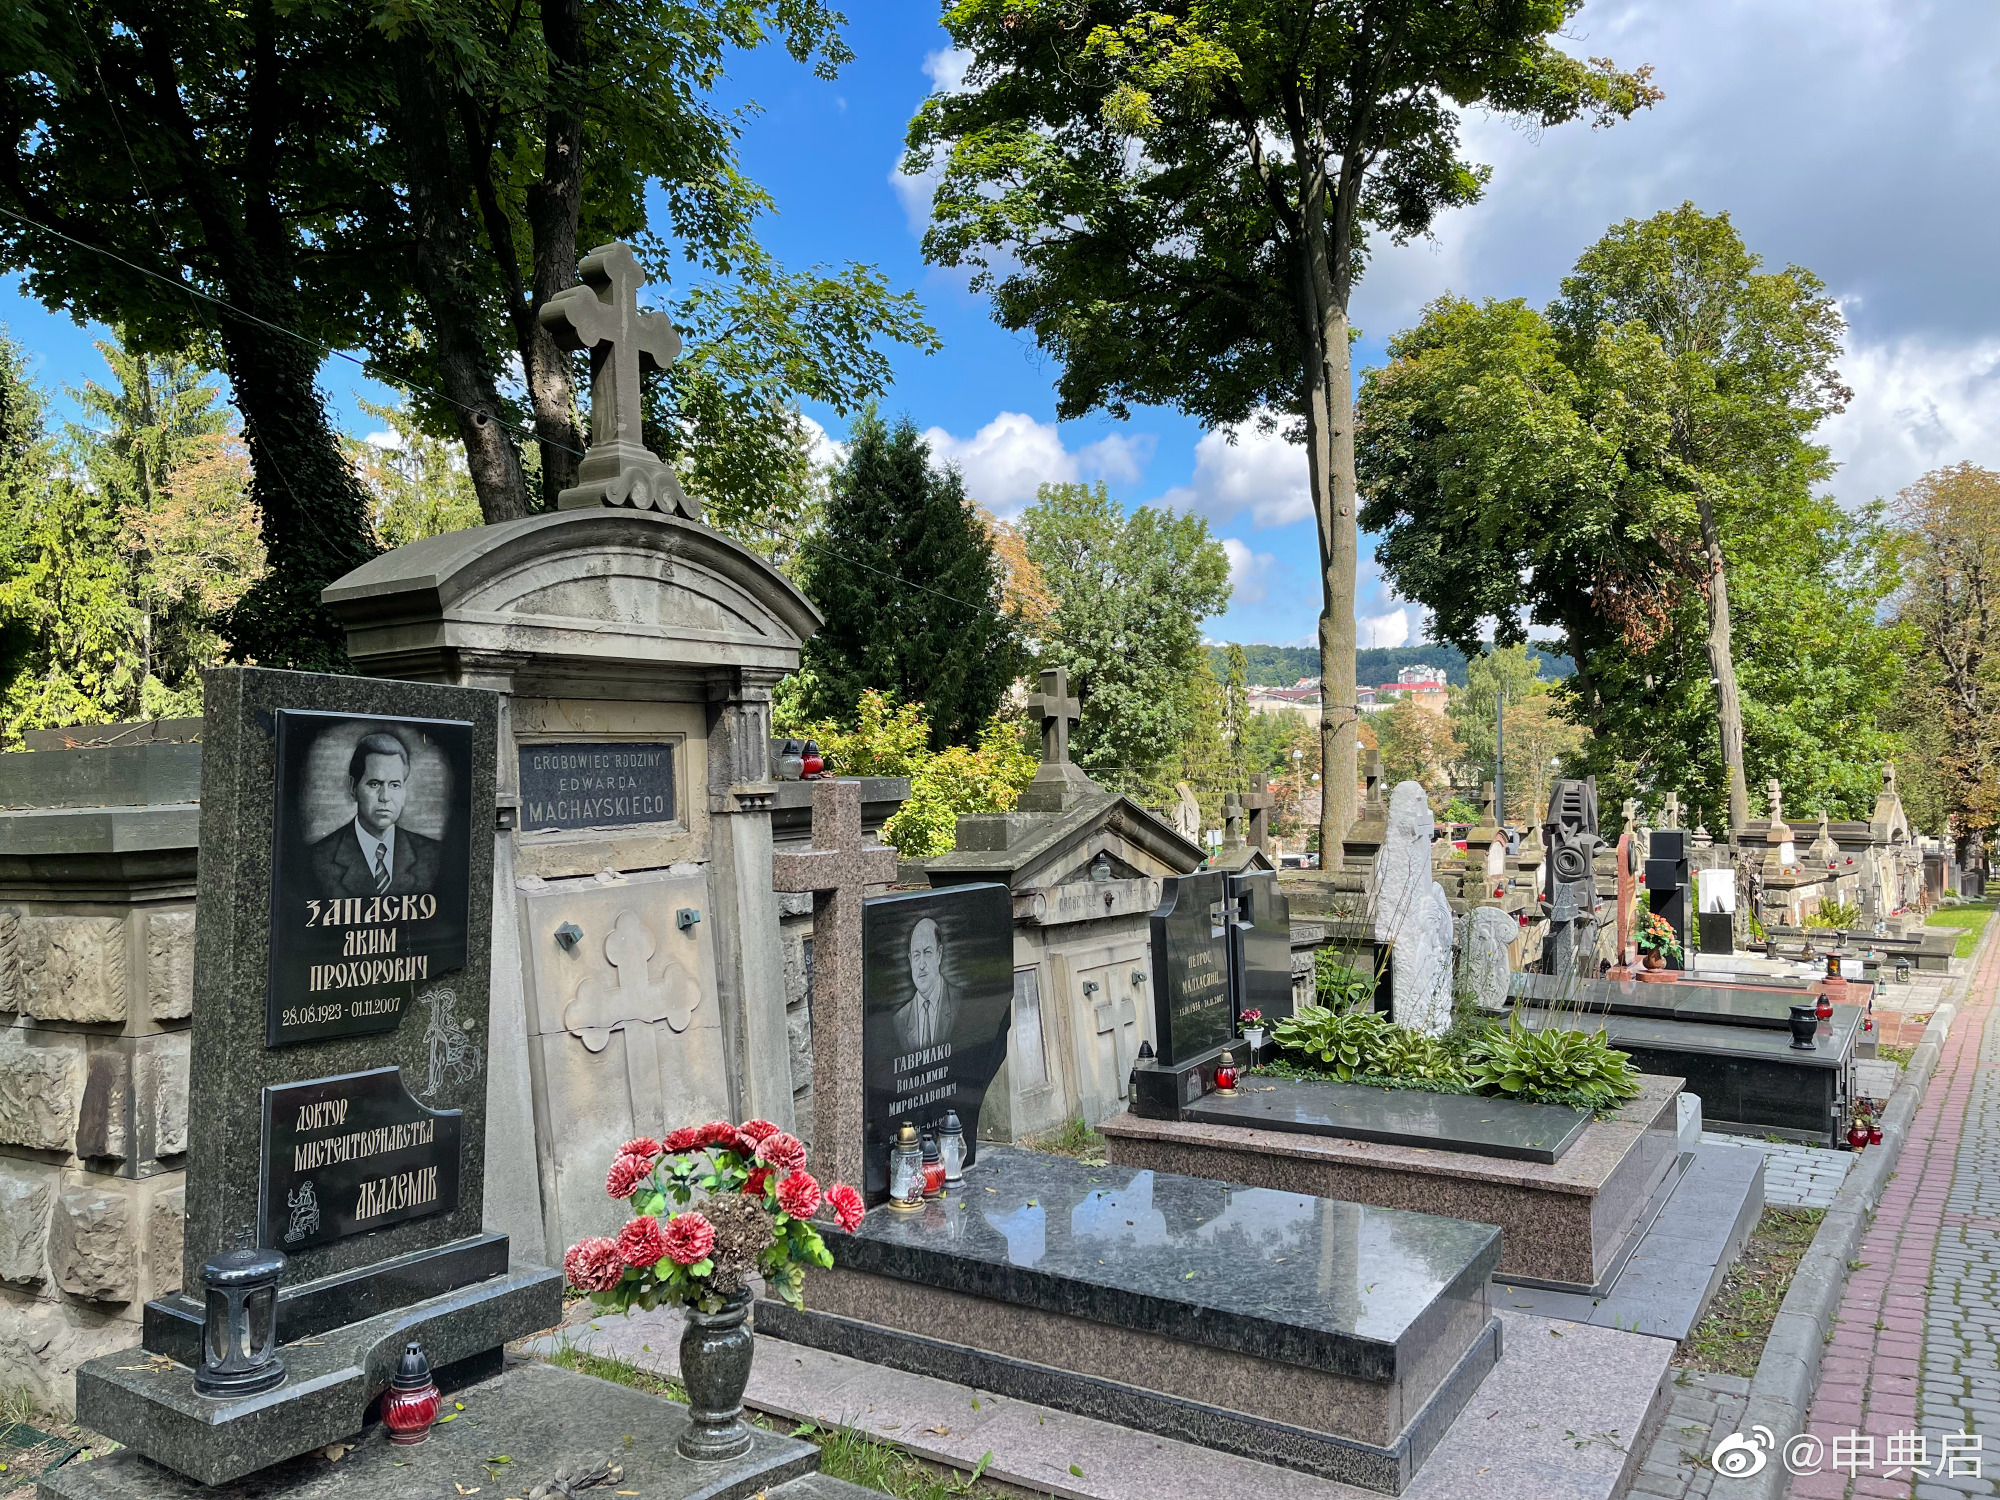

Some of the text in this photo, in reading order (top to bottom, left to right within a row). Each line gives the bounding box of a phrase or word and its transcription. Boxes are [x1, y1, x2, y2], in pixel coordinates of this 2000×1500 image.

[533, 753, 661, 770] GROBOWIEC RODZINY
[559, 776, 637, 791] EDWARDA
[529, 795, 664, 823] MACHAYSKIEGO
[305, 893, 437, 928] ЗАПАСКО
[343, 927, 397, 957] ЯКИМ
[309, 955, 428, 992] ПРОХОРОВИЧ
[1188, 950, 1212, 969] ПЕТРОС
[1182, 970, 1220, 995] МАЛХАСЯНЦ
[282, 1003, 342, 1027] 28.08.1923
[351, 998, 401, 1018] 01.11.2007
[893, 1042, 952, 1075] ГАВРИЛКО
[295, 1098, 348, 1133] ДОКТОР
[294, 1118, 435, 1173] МИСТЕЦТВОЗНАВСТВА
[355, 1165, 438, 1221] АКАДЕМІК
